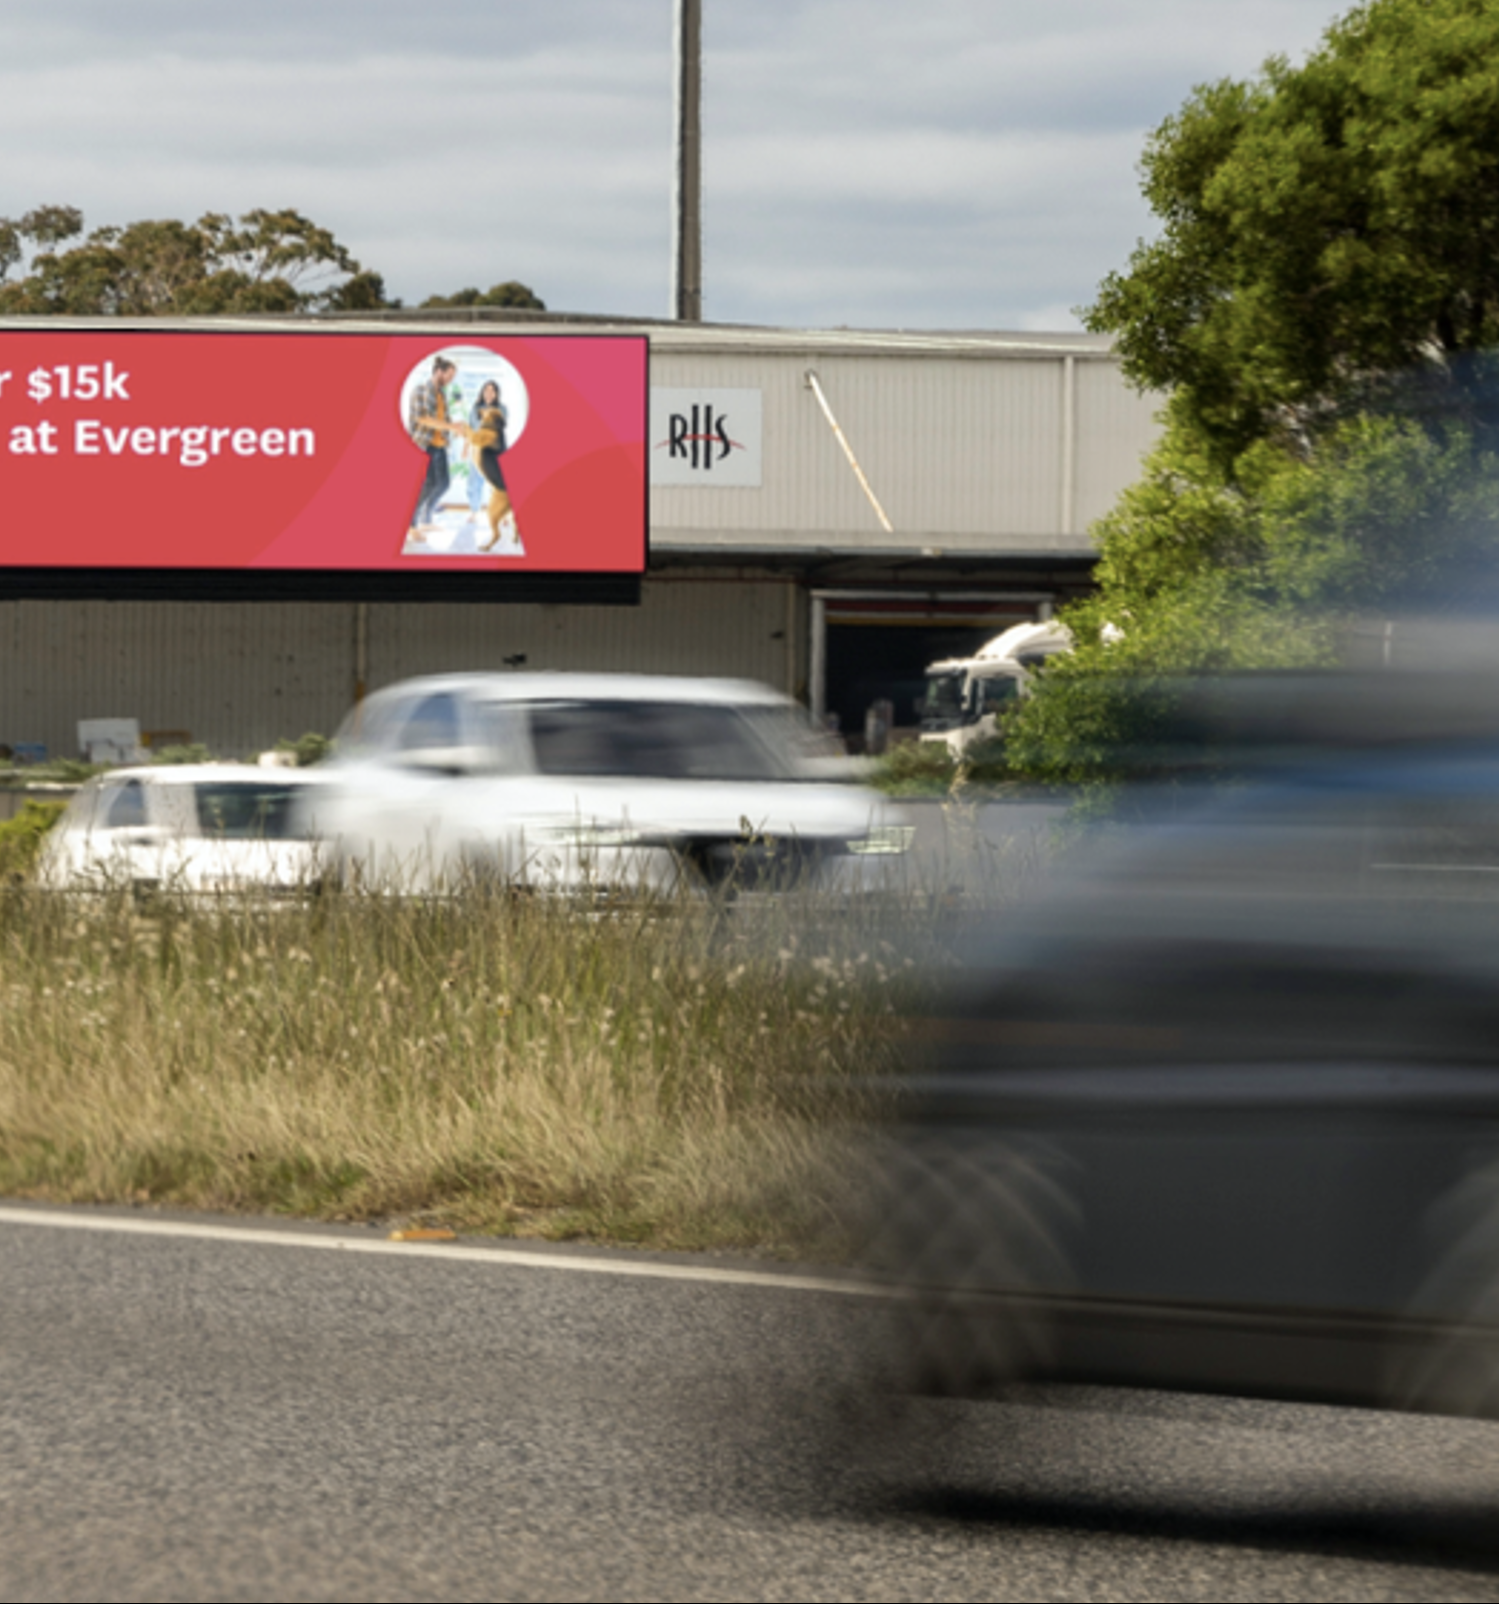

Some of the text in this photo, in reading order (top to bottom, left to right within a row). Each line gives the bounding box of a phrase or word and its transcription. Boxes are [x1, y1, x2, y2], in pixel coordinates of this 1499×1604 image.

[27, 360, 130, 403] $15k
[8, 420, 58, 454] at
[75, 419, 315, 467] Evergreen
